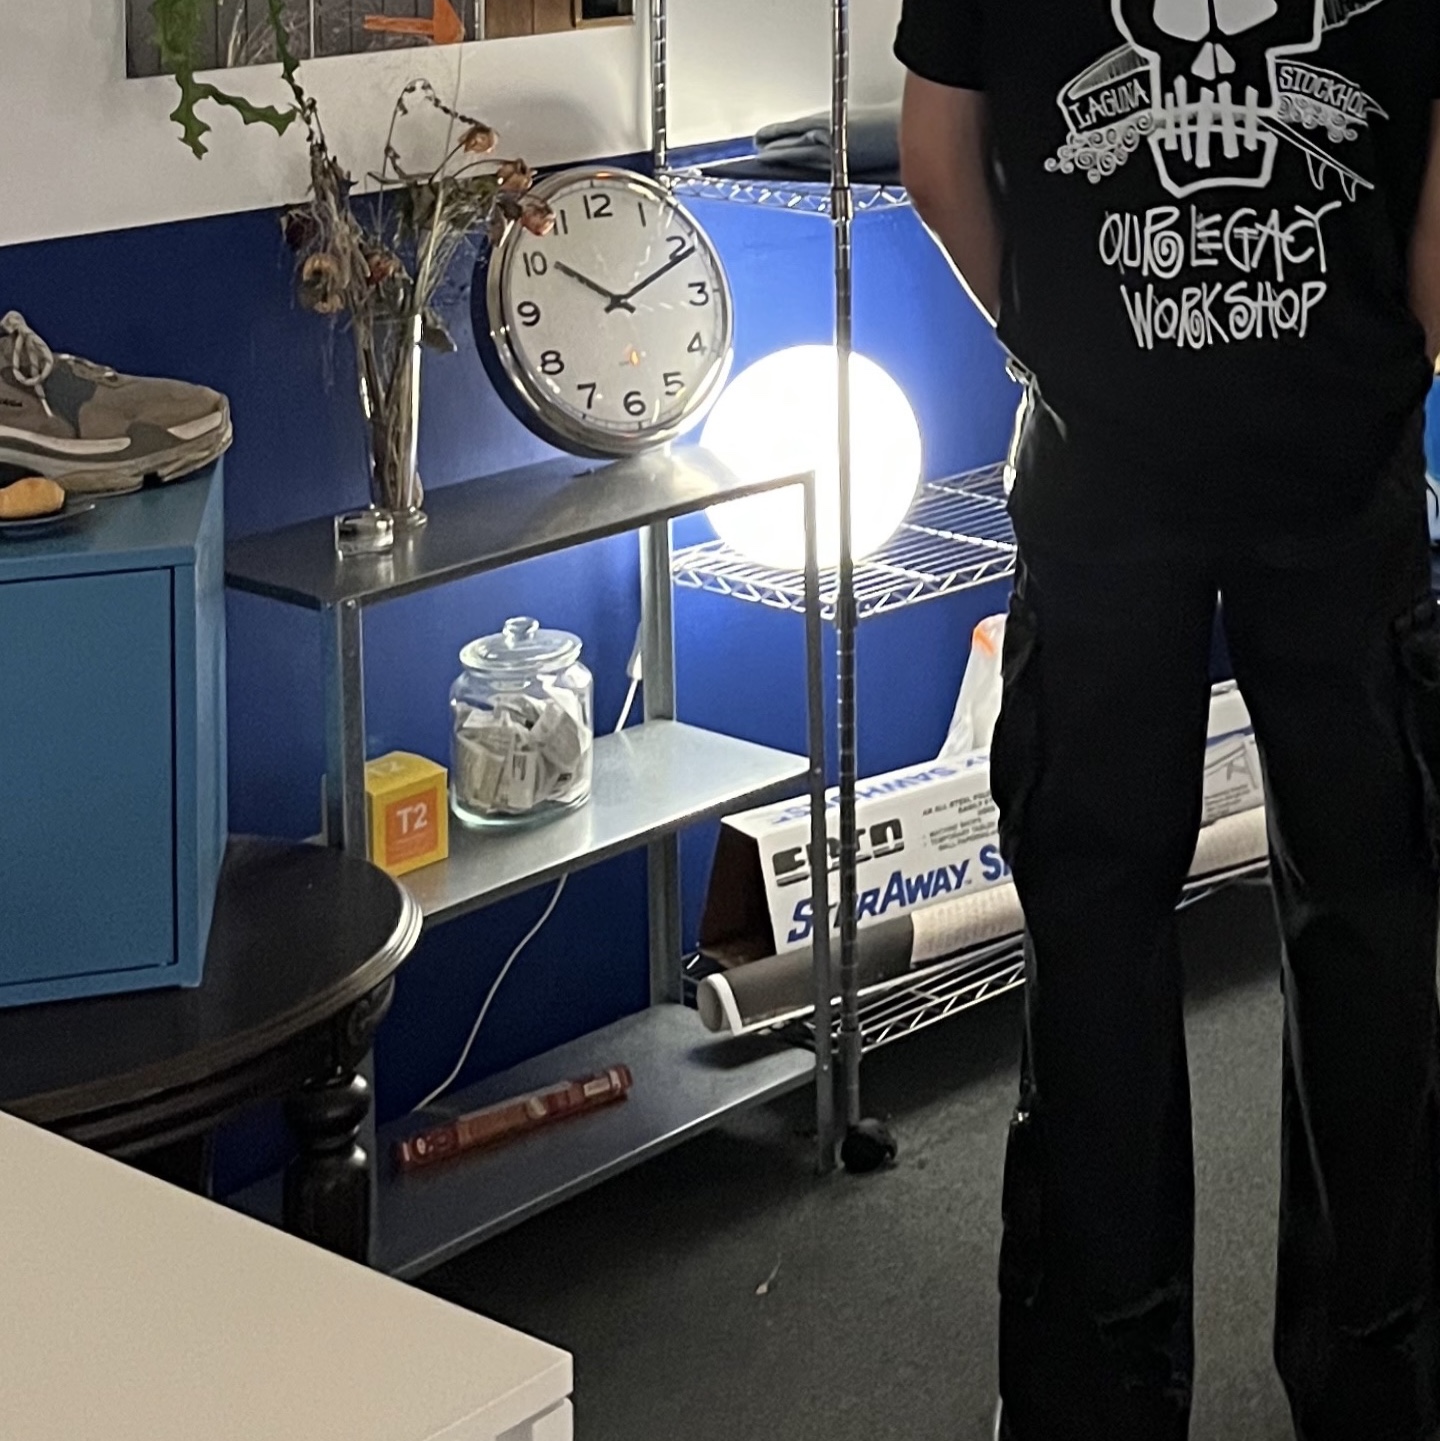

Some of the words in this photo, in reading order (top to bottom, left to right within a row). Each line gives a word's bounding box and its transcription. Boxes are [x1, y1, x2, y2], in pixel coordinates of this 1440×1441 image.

[1068, 81, 1150, 129] LAGUNA
[583, 193, 613, 220] 12
[637, 202, 646, 228] 1
[665, 236, 689, 261] 2
[1100, 205, 1184, 278] OUR
[1190, 200, 1342, 282] LEGACY
[523, 251, 548, 278] 10
[687, 281, 709, 306] 3
[517, 301, 541, 326] 9
[1120, 280, 1326, 349] WORKSHOP
[686, 331, 707, 356] 4
[540, 350, 565, 376] 8
[576, 382, 597, 409] 7
[662, 371, 686, 396] 5
[622, 390, 646, 416] 6
[396, 802, 428, 835] T2
